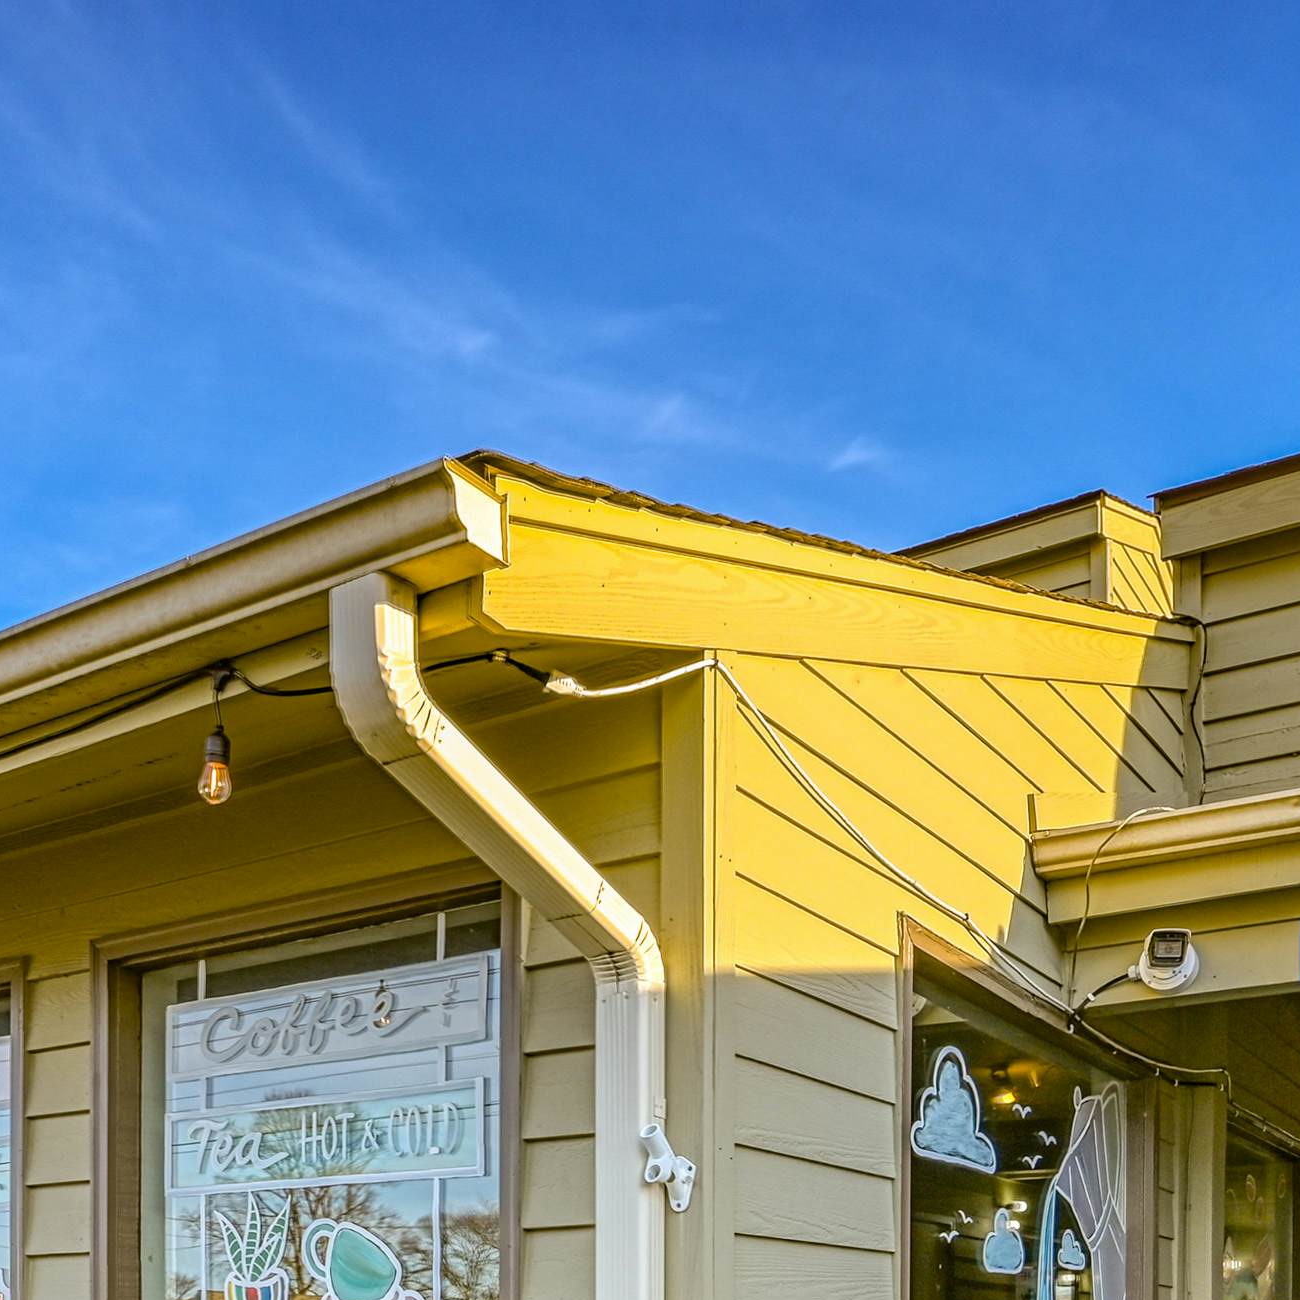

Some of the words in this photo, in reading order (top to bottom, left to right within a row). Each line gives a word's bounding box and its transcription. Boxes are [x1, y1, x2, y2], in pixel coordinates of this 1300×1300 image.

[201, 989, 429, 1064] Coffee
[188, 1118, 289, 1174] Tea
[300, 1111, 356, 1163] HOT
[361, 1120, 382, 1152] &
[389, 1101, 461, 1158] COLD
